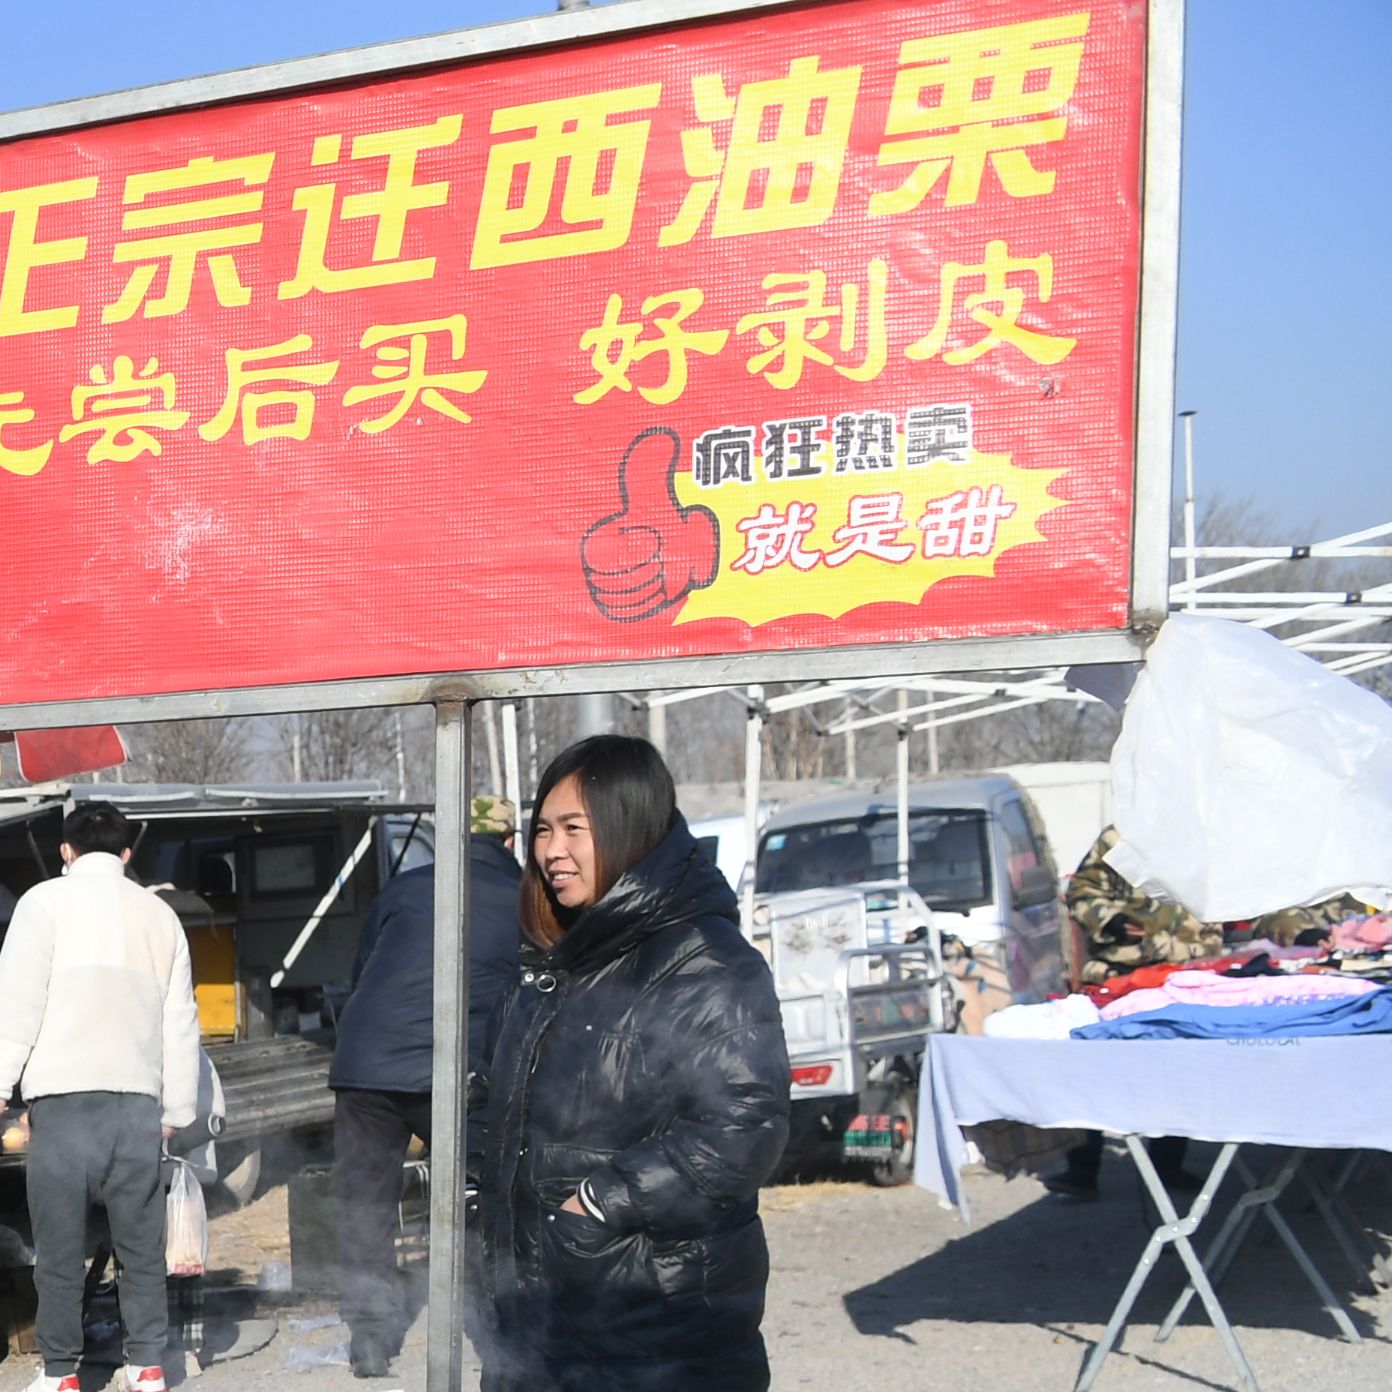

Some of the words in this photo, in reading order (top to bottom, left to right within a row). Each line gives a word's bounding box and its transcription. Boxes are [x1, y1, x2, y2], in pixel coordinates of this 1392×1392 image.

[575, 240, 1076, 404] 好剥皮
[695, 404, 973, 487] 疯狂热卖
[731, 484, 1017, 573] 就是甜
